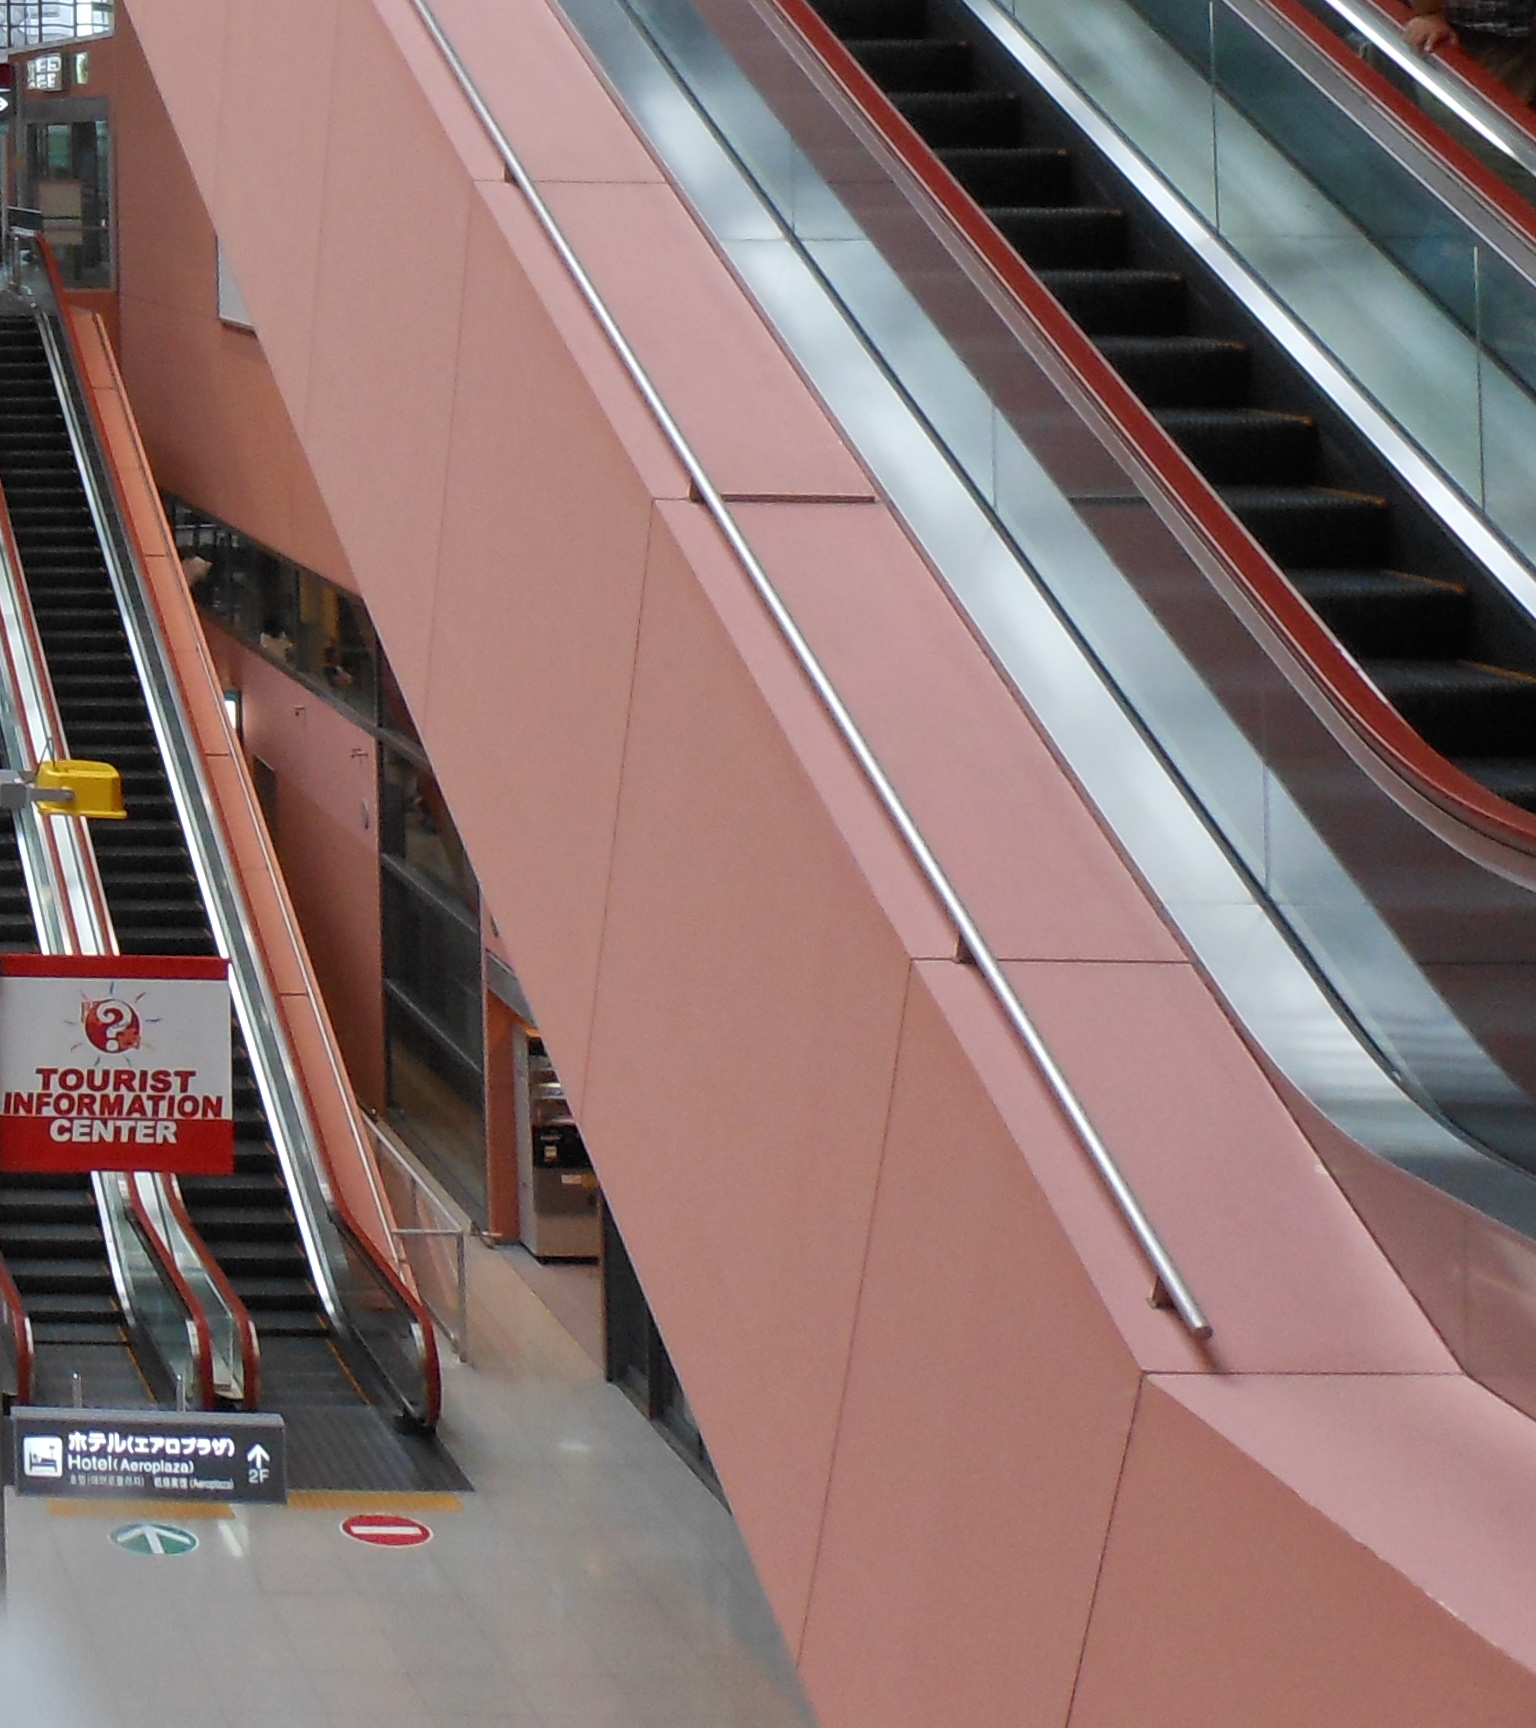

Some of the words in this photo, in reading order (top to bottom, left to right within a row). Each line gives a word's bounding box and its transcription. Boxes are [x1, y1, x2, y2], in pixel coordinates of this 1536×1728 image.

[35, 1067, 196, 1094] TOURIST
[3, 1091, 224, 1120] INFORMATION
[48, 1118, 178, 1145] CENTER
[68, 1431, 235, 1457] ホテル(エアロプラザ)
[248, 1470, 269, 1484] 2F
